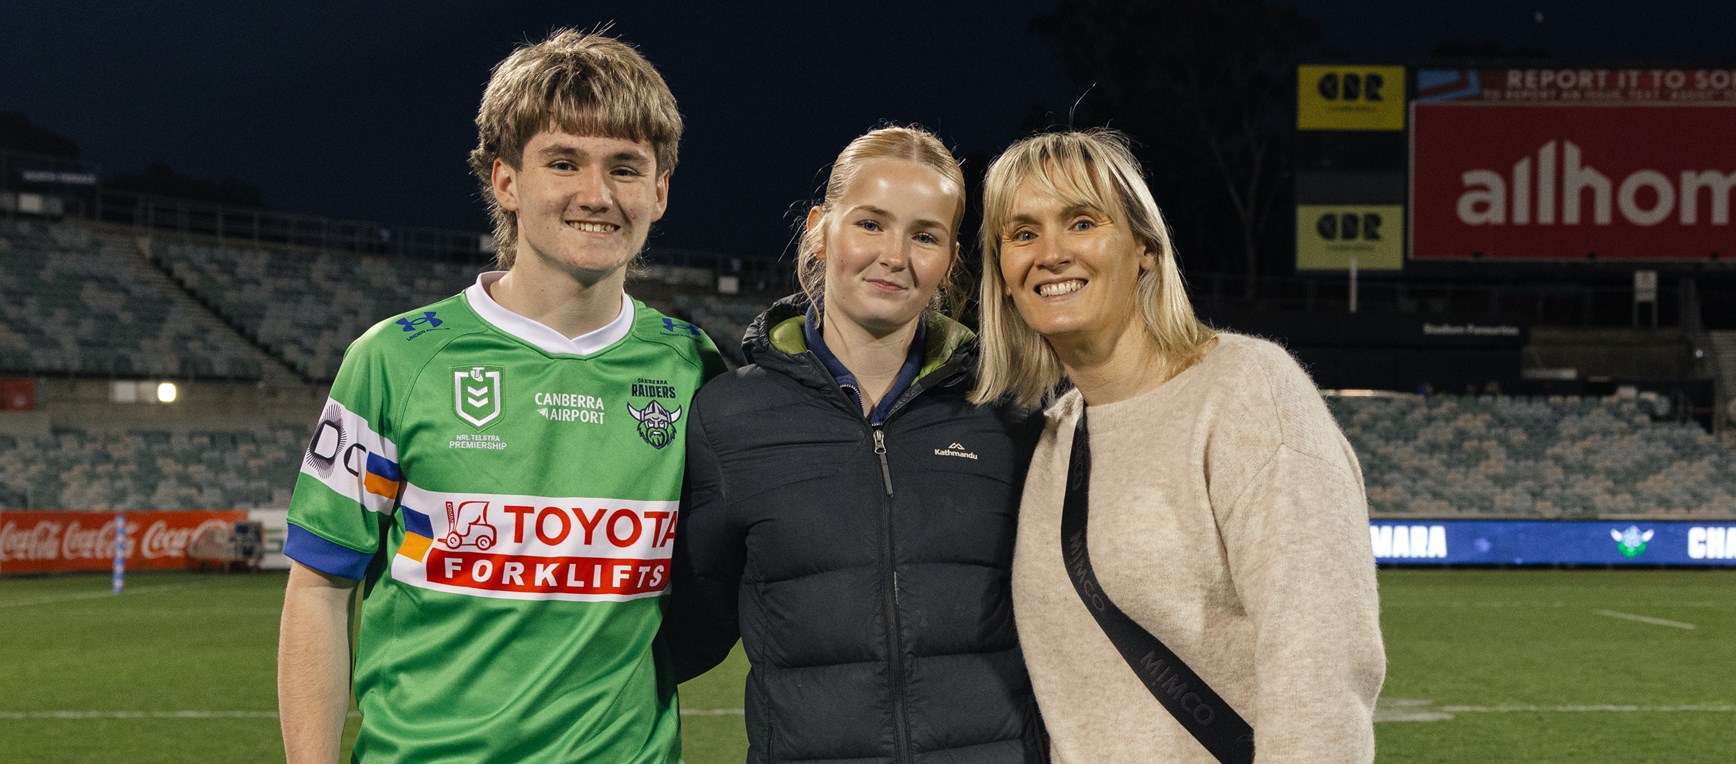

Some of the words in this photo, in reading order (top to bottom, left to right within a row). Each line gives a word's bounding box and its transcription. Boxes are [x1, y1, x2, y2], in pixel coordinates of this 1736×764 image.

[1318, 73, 1384, 101] CBR
[1507, 69, 1608, 89] REPORT
[1618, 69, 1639, 88] IT
[1651, 69, 1685, 89] TO
[1317, 212, 1382, 241] CBR
[534, 392, 605, 410] CANBERRA
[631, 384, 676, 399] RAIDERS
[550, 408, 605, 425] AIRPORT
[449, 441, 507, 450] PREMIERSHIP
[471, 434, 500, 442] TELSTRA
[934, 448, 978, 460] Kathmandu
[503, 505, 679, 549] TOYOTA
[444, 557, 665, 588] FORKLIFTS
[1069, 530, 1106, 614] MIMCO
[1140, 650, 1216, 727] MIMCO
